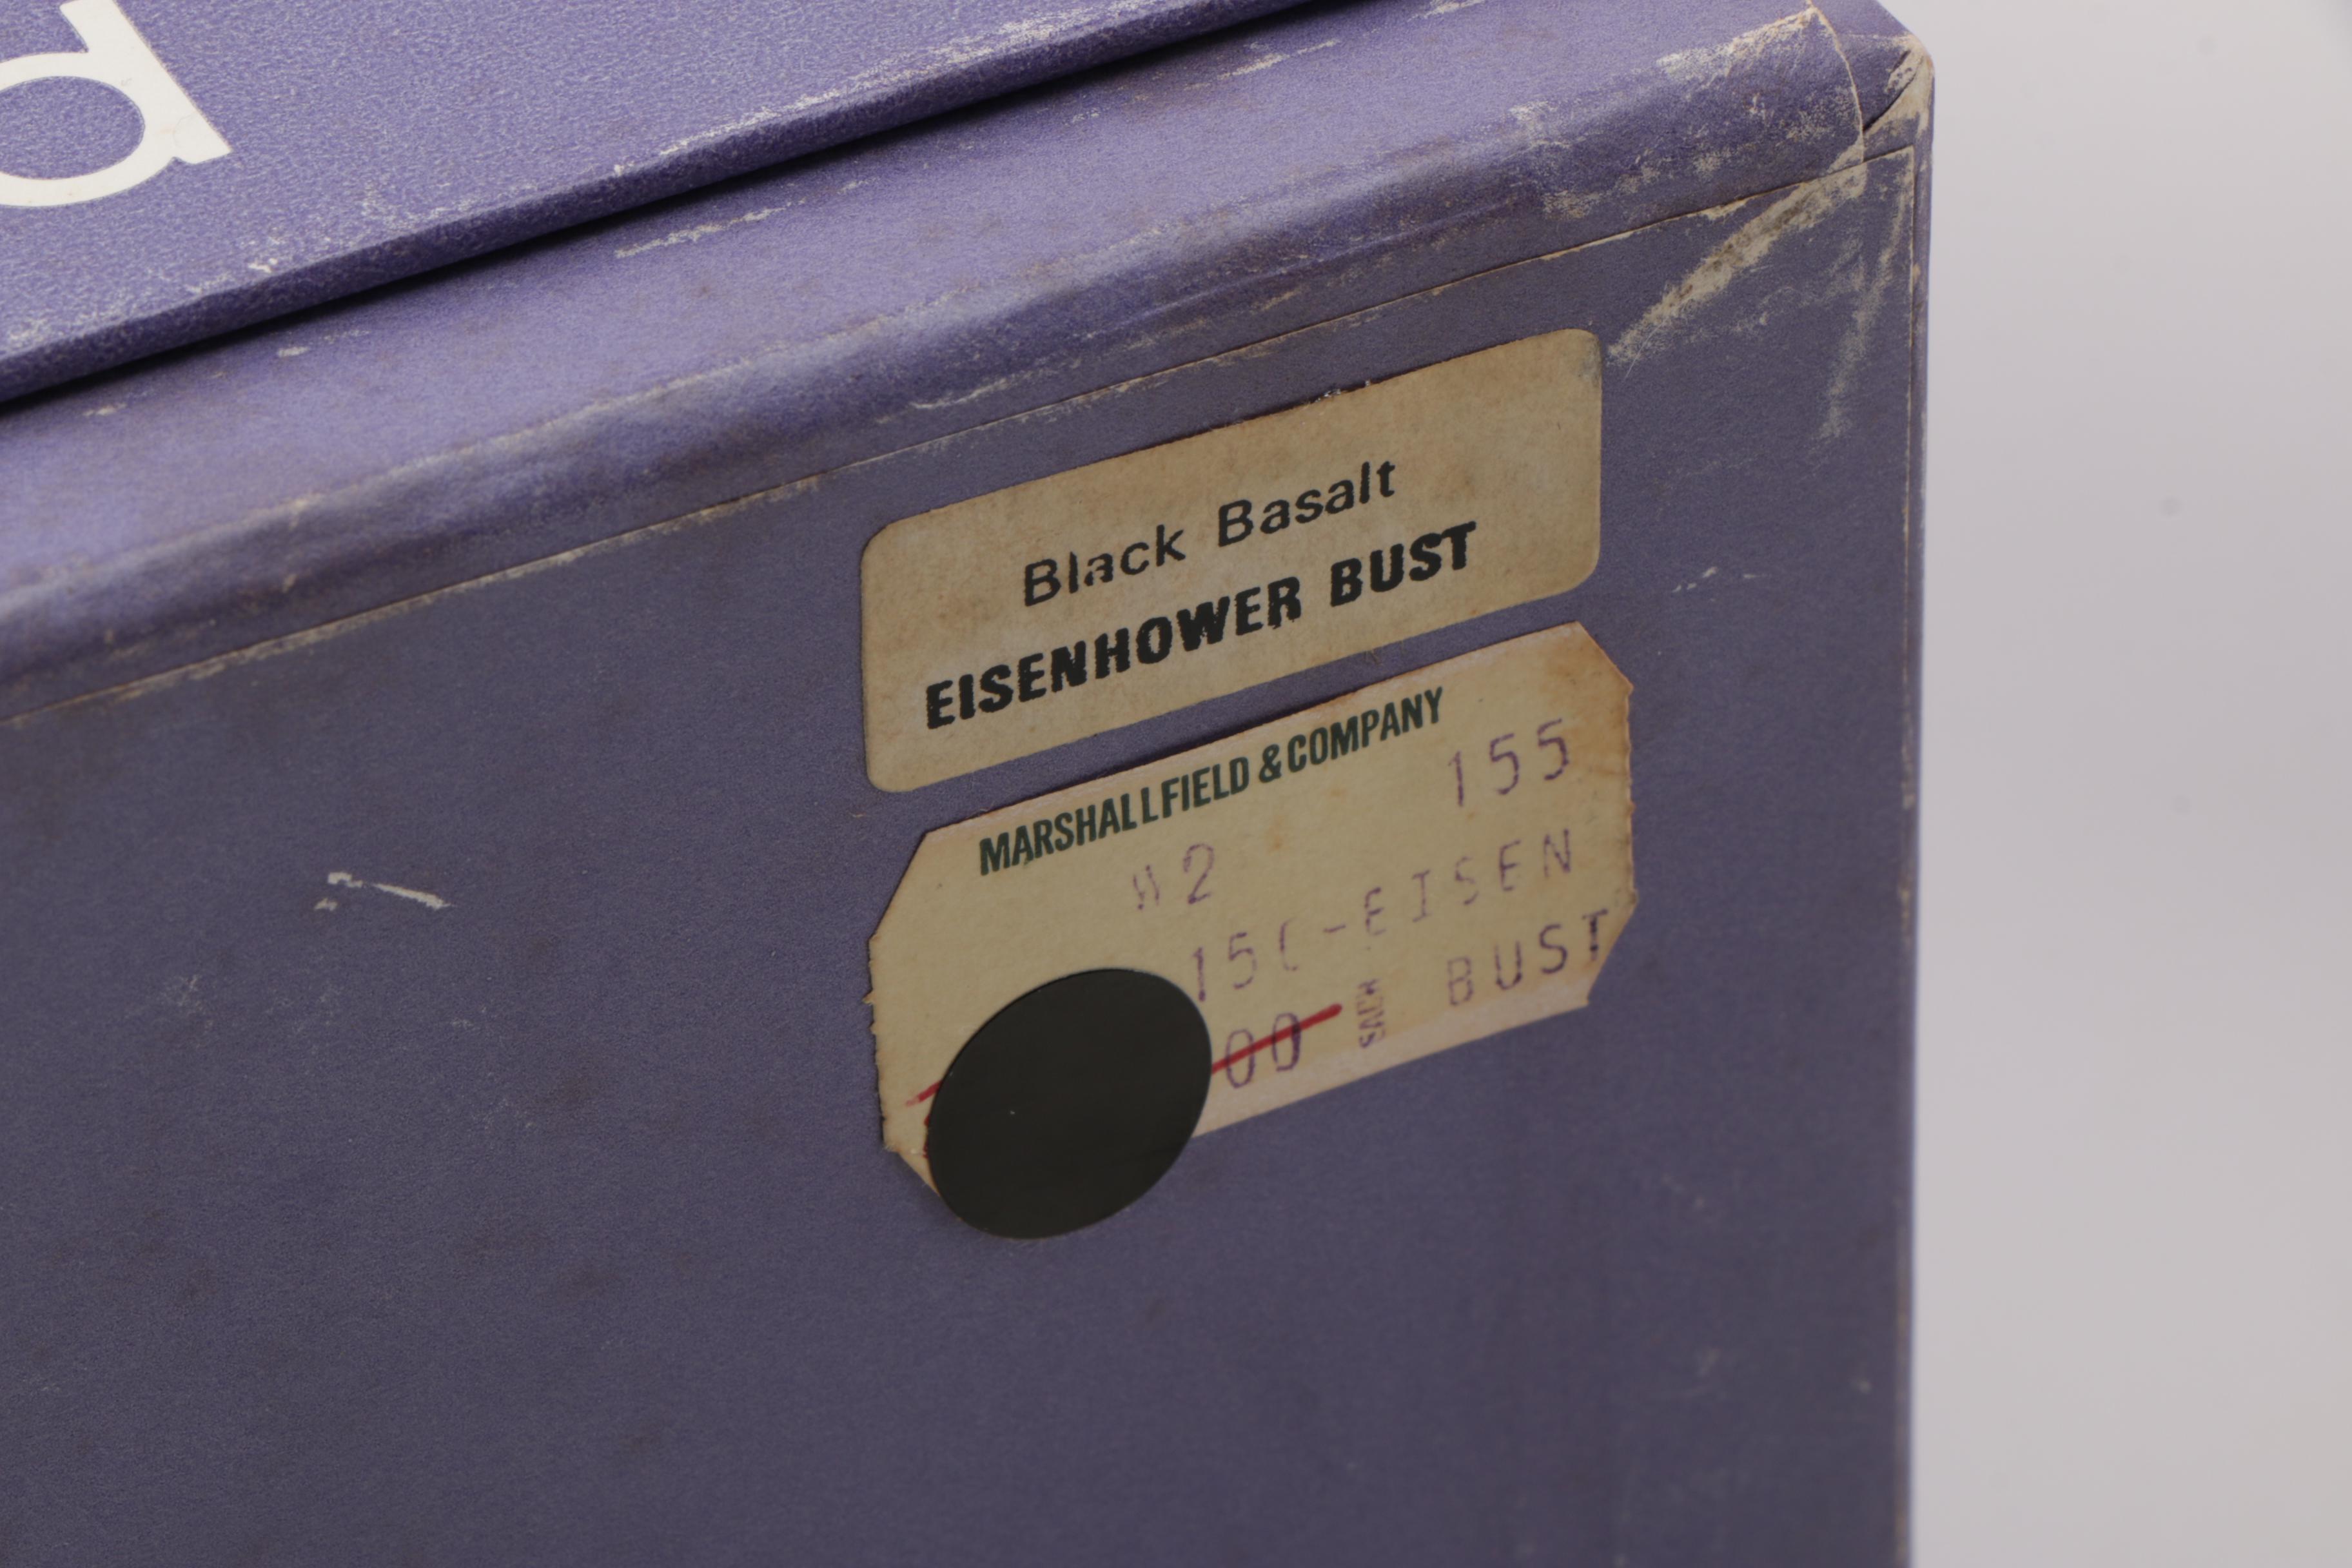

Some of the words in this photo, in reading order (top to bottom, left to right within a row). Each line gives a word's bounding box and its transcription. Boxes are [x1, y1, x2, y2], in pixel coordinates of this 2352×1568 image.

[1024, 524, 1186, 607] Black
[1217, 460, 1396, 548] Basalt
[925, 576, 1301, 730] EISENHOWER
[1329, 521, 1477, 607] BUST
[979, 787, 1158, 876] MARSHALL
[1161, 756, 1250, 819] FIELD
[1258, 743, 1283, 784] &
[1287, 686, 1444, 774] COMPANY
[1447, 718, 1570, 808] 155
[1447, 908, 1609, 1007] BUST
